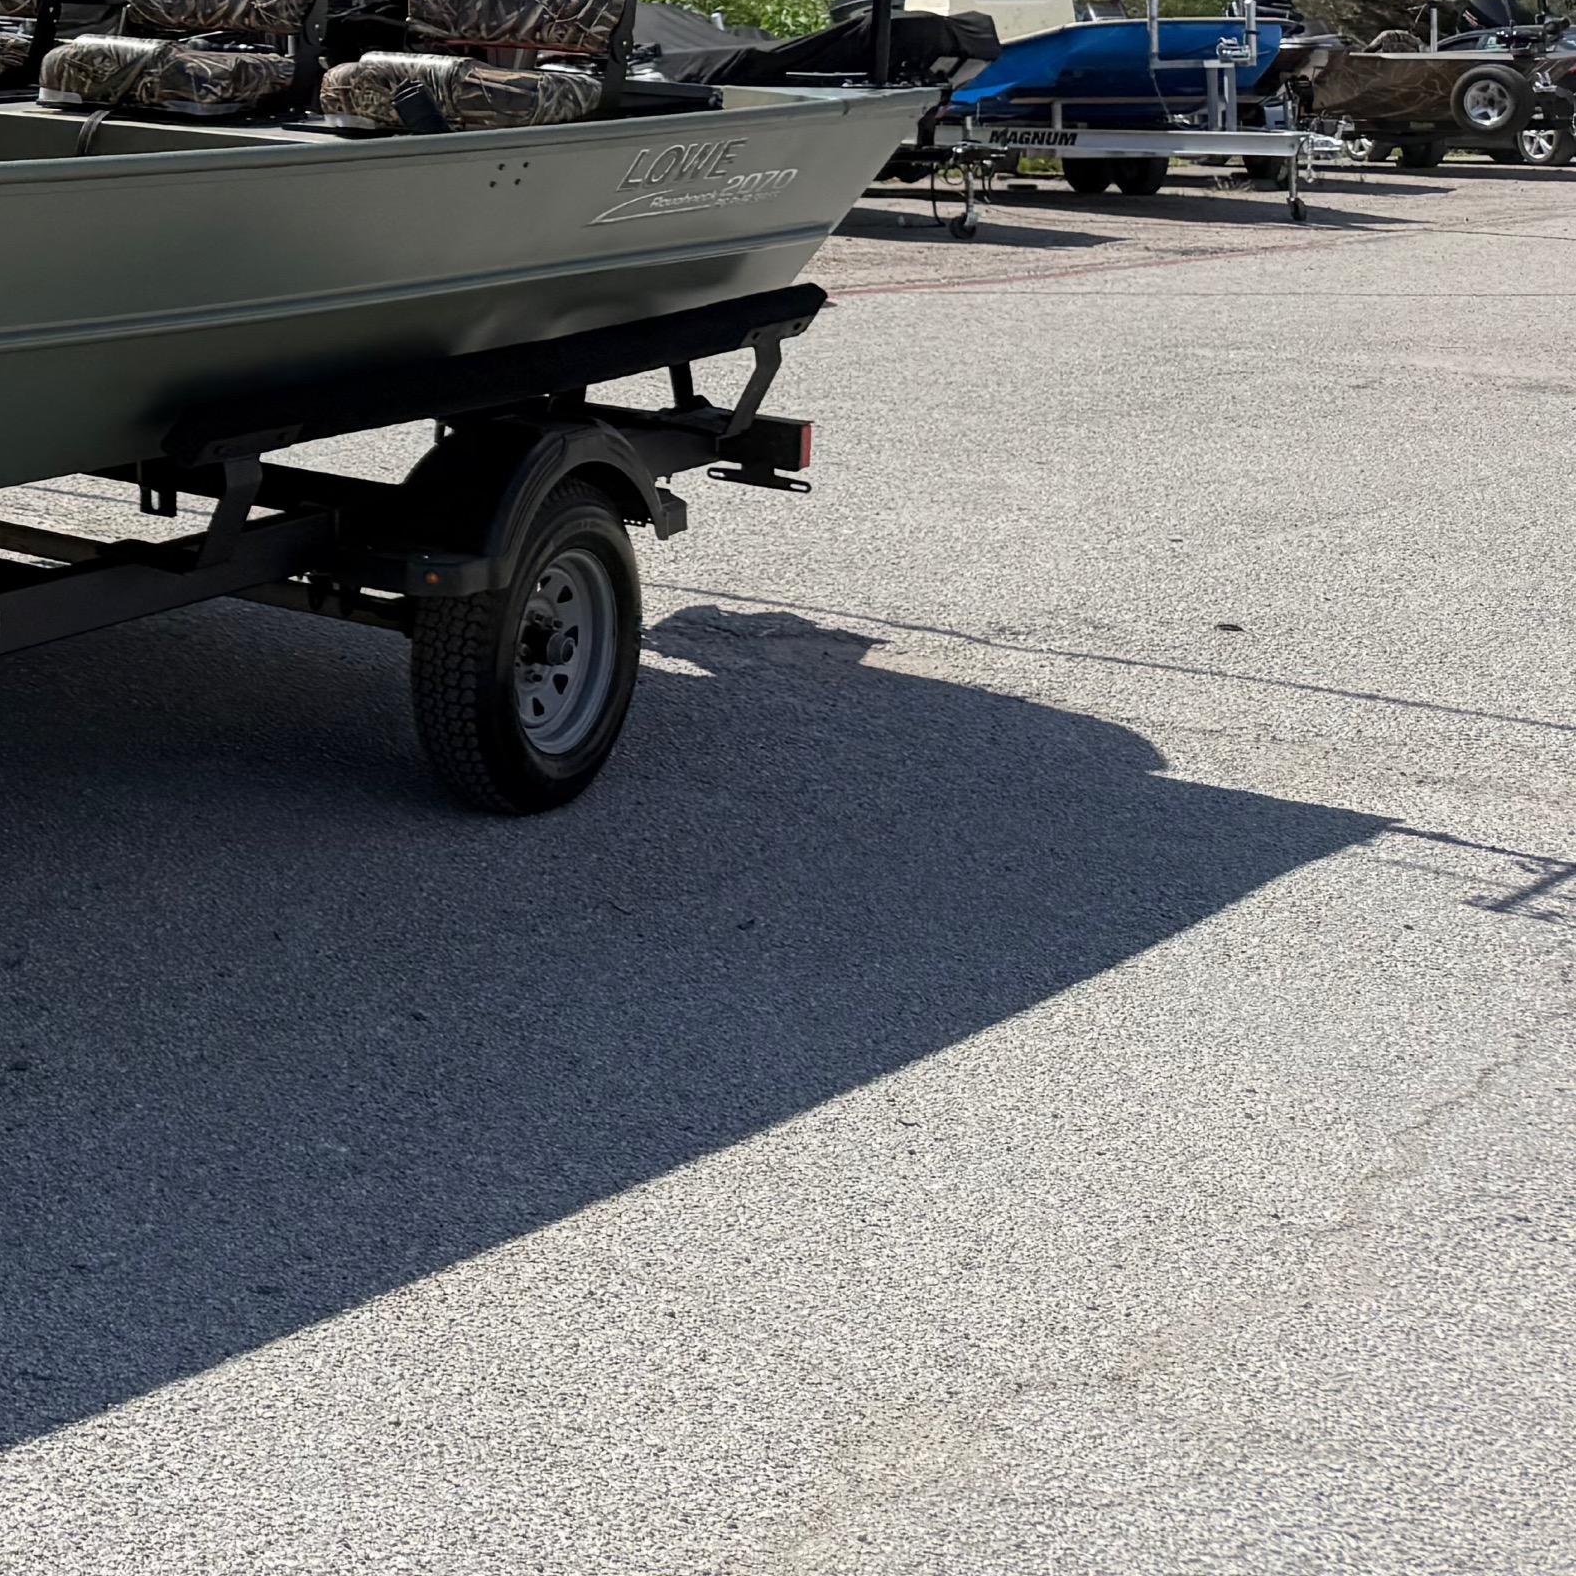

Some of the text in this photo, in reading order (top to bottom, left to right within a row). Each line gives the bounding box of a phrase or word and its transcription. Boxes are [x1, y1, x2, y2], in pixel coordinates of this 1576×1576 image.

[988, 129, 1078, 145] MAGNUM
[616, 137, 750, 192] LOWE
[721, 168, 798, 196] 2070
